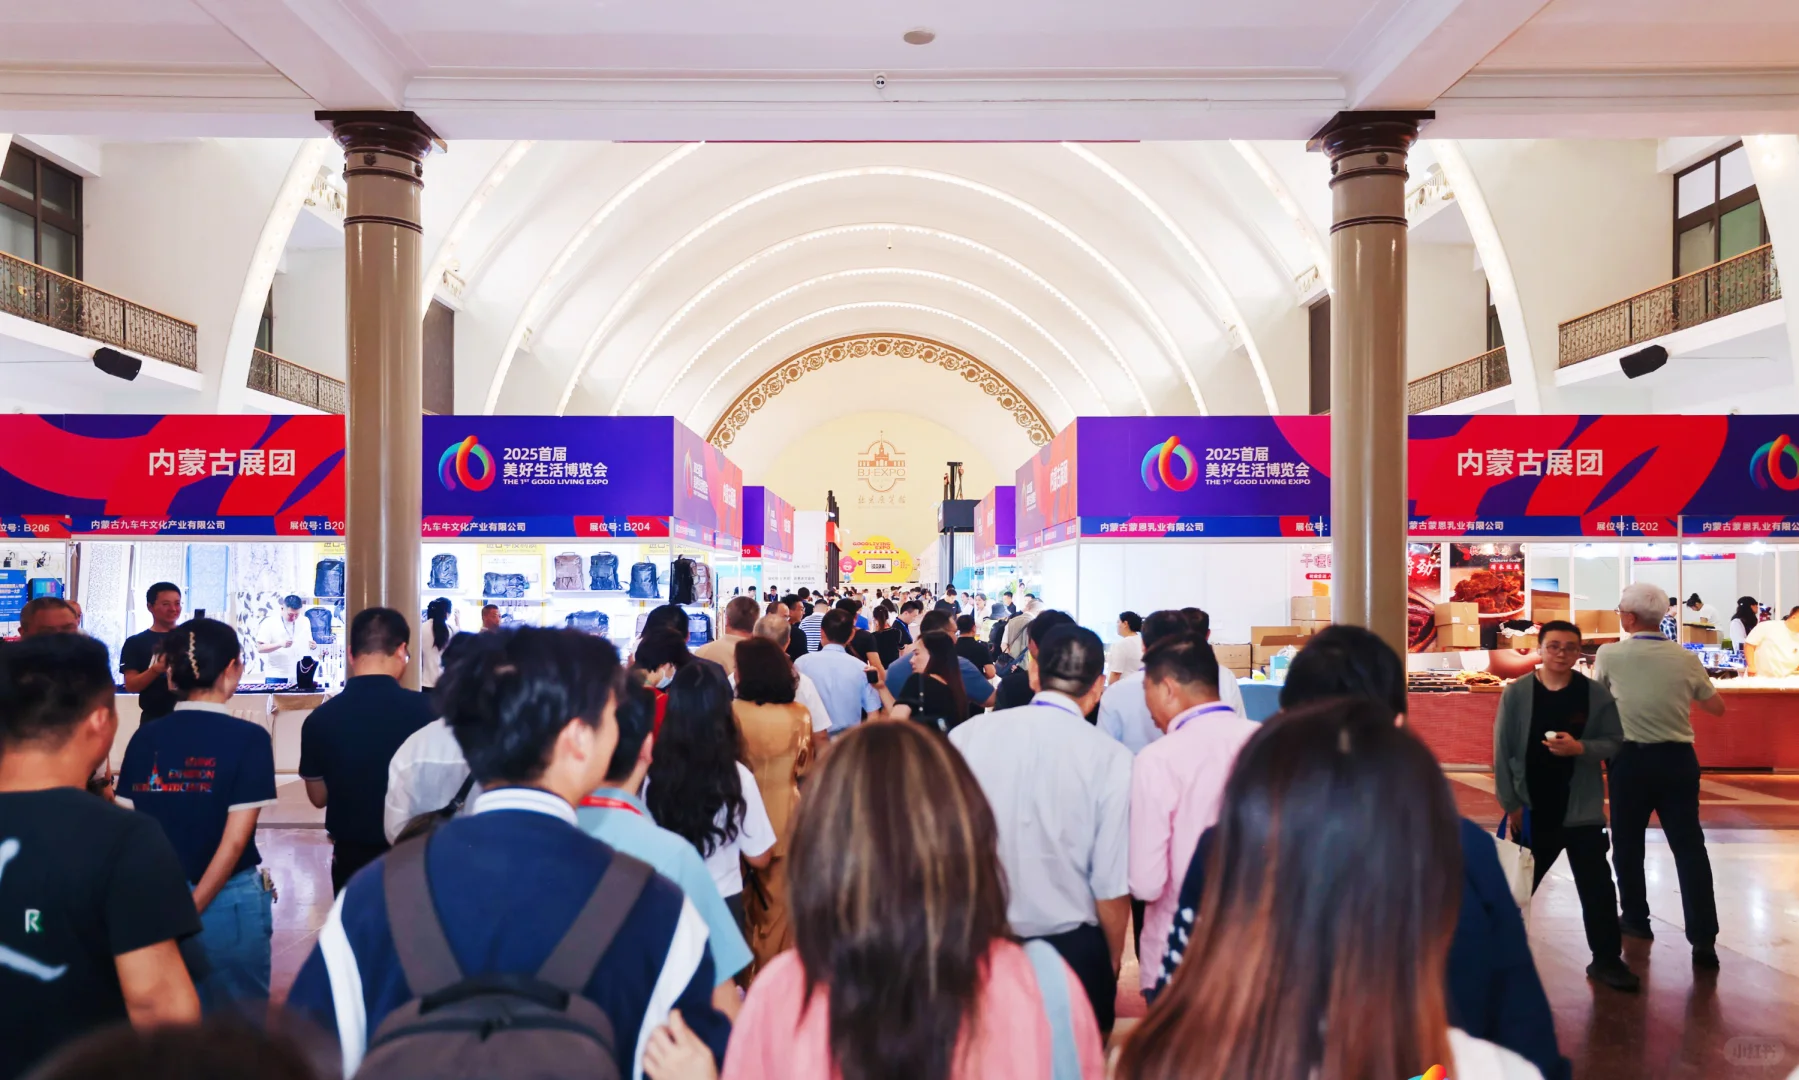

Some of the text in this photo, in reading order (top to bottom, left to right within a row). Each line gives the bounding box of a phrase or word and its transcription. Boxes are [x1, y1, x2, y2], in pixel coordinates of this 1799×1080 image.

[503, 446, 567, 462] 2025首届
[1205, 446, 1269, 462] 2025首届
[148, 448, 296, 477] 内蒙古展团
[1457, 448, 1603, 477] 内蒙古展团
[503, 462, 608, 478] 美好生活博览会
[1205, 462, 1310, 478] 美好生活博览会
[503, 478, 519, 486] THE
[531, 478, 556, 486] GOOD
[557, 478, 585, 486] LIVING
[586, 478, 609, 486] EXPO
[1205, 478, 1221, 486] THE
[1233, 478, 1258, 486] GOOD
[1259, 478, 1287, 486] LIVING
[1287, 478, 1311, 486] EXPO
[23, 523, 50, 533] B206
[90, 519, 226, 531] 内蒙古九车牛文化产业有限公司
[289, 520, 322, 531] 展位号:
[422, 521, 526, 533] 九车牛文化产业有限公司
[589, 522, 651, 532] 展位号: B204
[1099, 521, 1204, 533] 内蒙古蒙恩乳业有限公司
[1295, 521, 1329, 532] 展位号:
[1408, 520, 1504, 531] 蒙古蒙恩乳业有限公司
[1596, 521, 1659, 532] 展位号: B202
